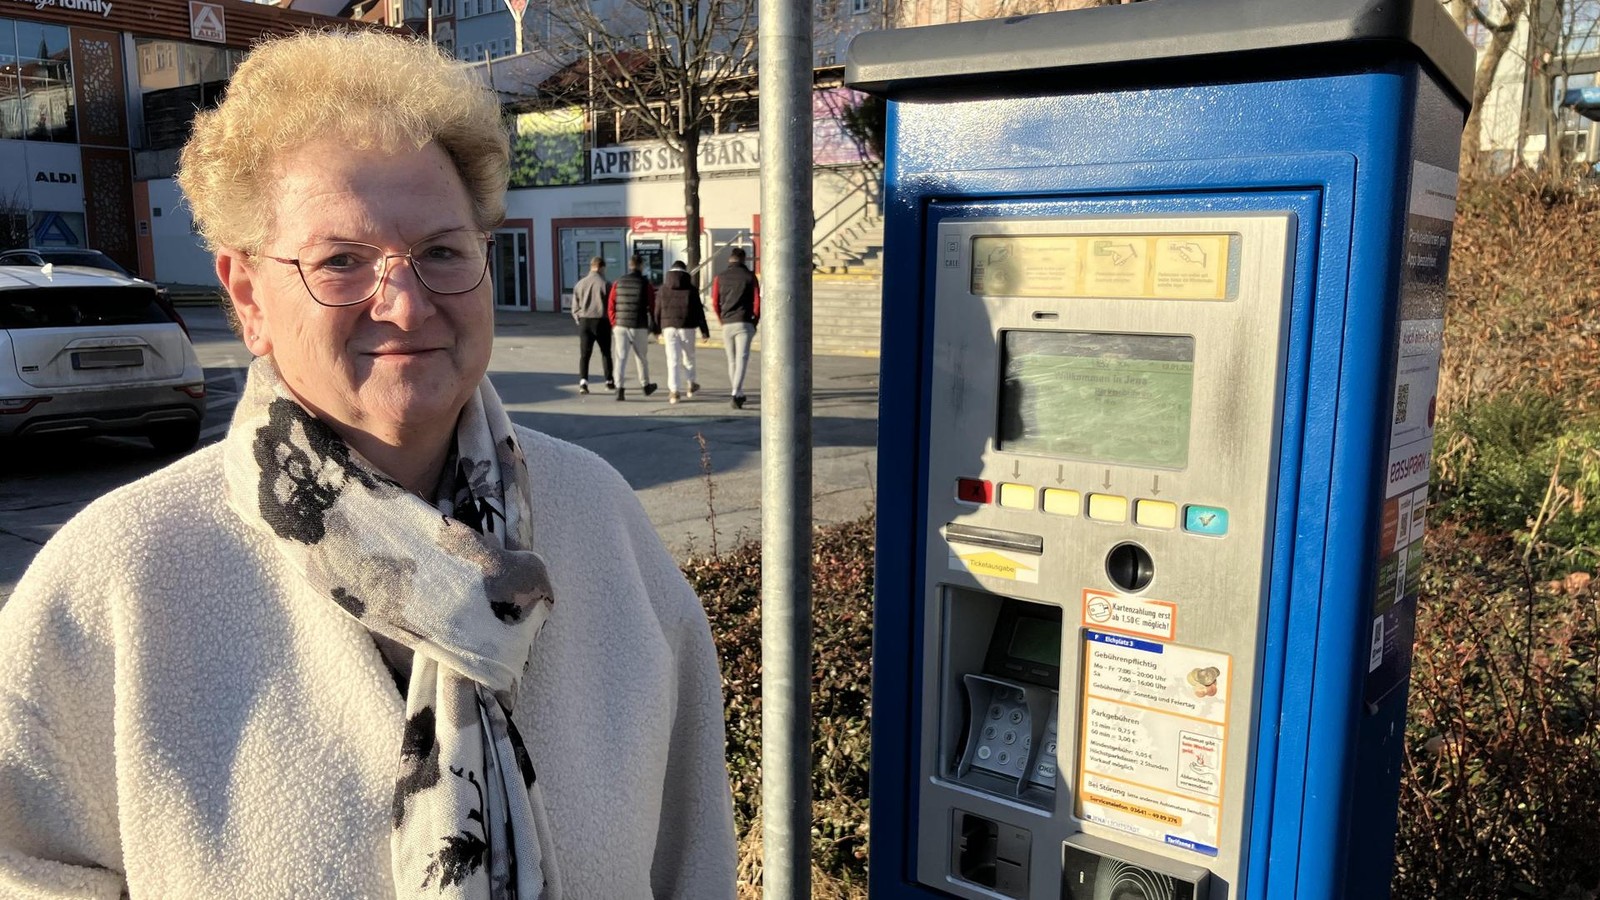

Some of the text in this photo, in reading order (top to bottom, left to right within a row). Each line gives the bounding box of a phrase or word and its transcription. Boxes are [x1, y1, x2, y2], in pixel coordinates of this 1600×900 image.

[198, 30, 220, 38] ALDI
[594, 149, 651, 175] APRES
[704, 140, 746, 166] BAR
[35, 171, 77, 184] ALDI
[970, 560, 1014, 572] Ticketausgabe
[1112, 603, 1171, 620] Kartenzahlung erst
[1142, 620, 1170, 630] möglich!
[1105, 636, 1129, 646] Eichplatz
[1094, 651, 1157, 670] Gebührenpflichtig
[1137, 671, 1154, 680] 20:00
[1134, 691, 1157, 701] Sonntag
[1171, 698, 1196, 709] Feiertag
[1091, 709, 1140, 725] Parkgebühren
[1090, 756, 1134, 771] Vorkauf möglich
[1145, 760, 1169, 771] Stunden
[1100, 784, 1125, 797] Störung
[1090, 796, 1128, 810] Servicetelefon
[1130, 807, 1147, 815] 03641
